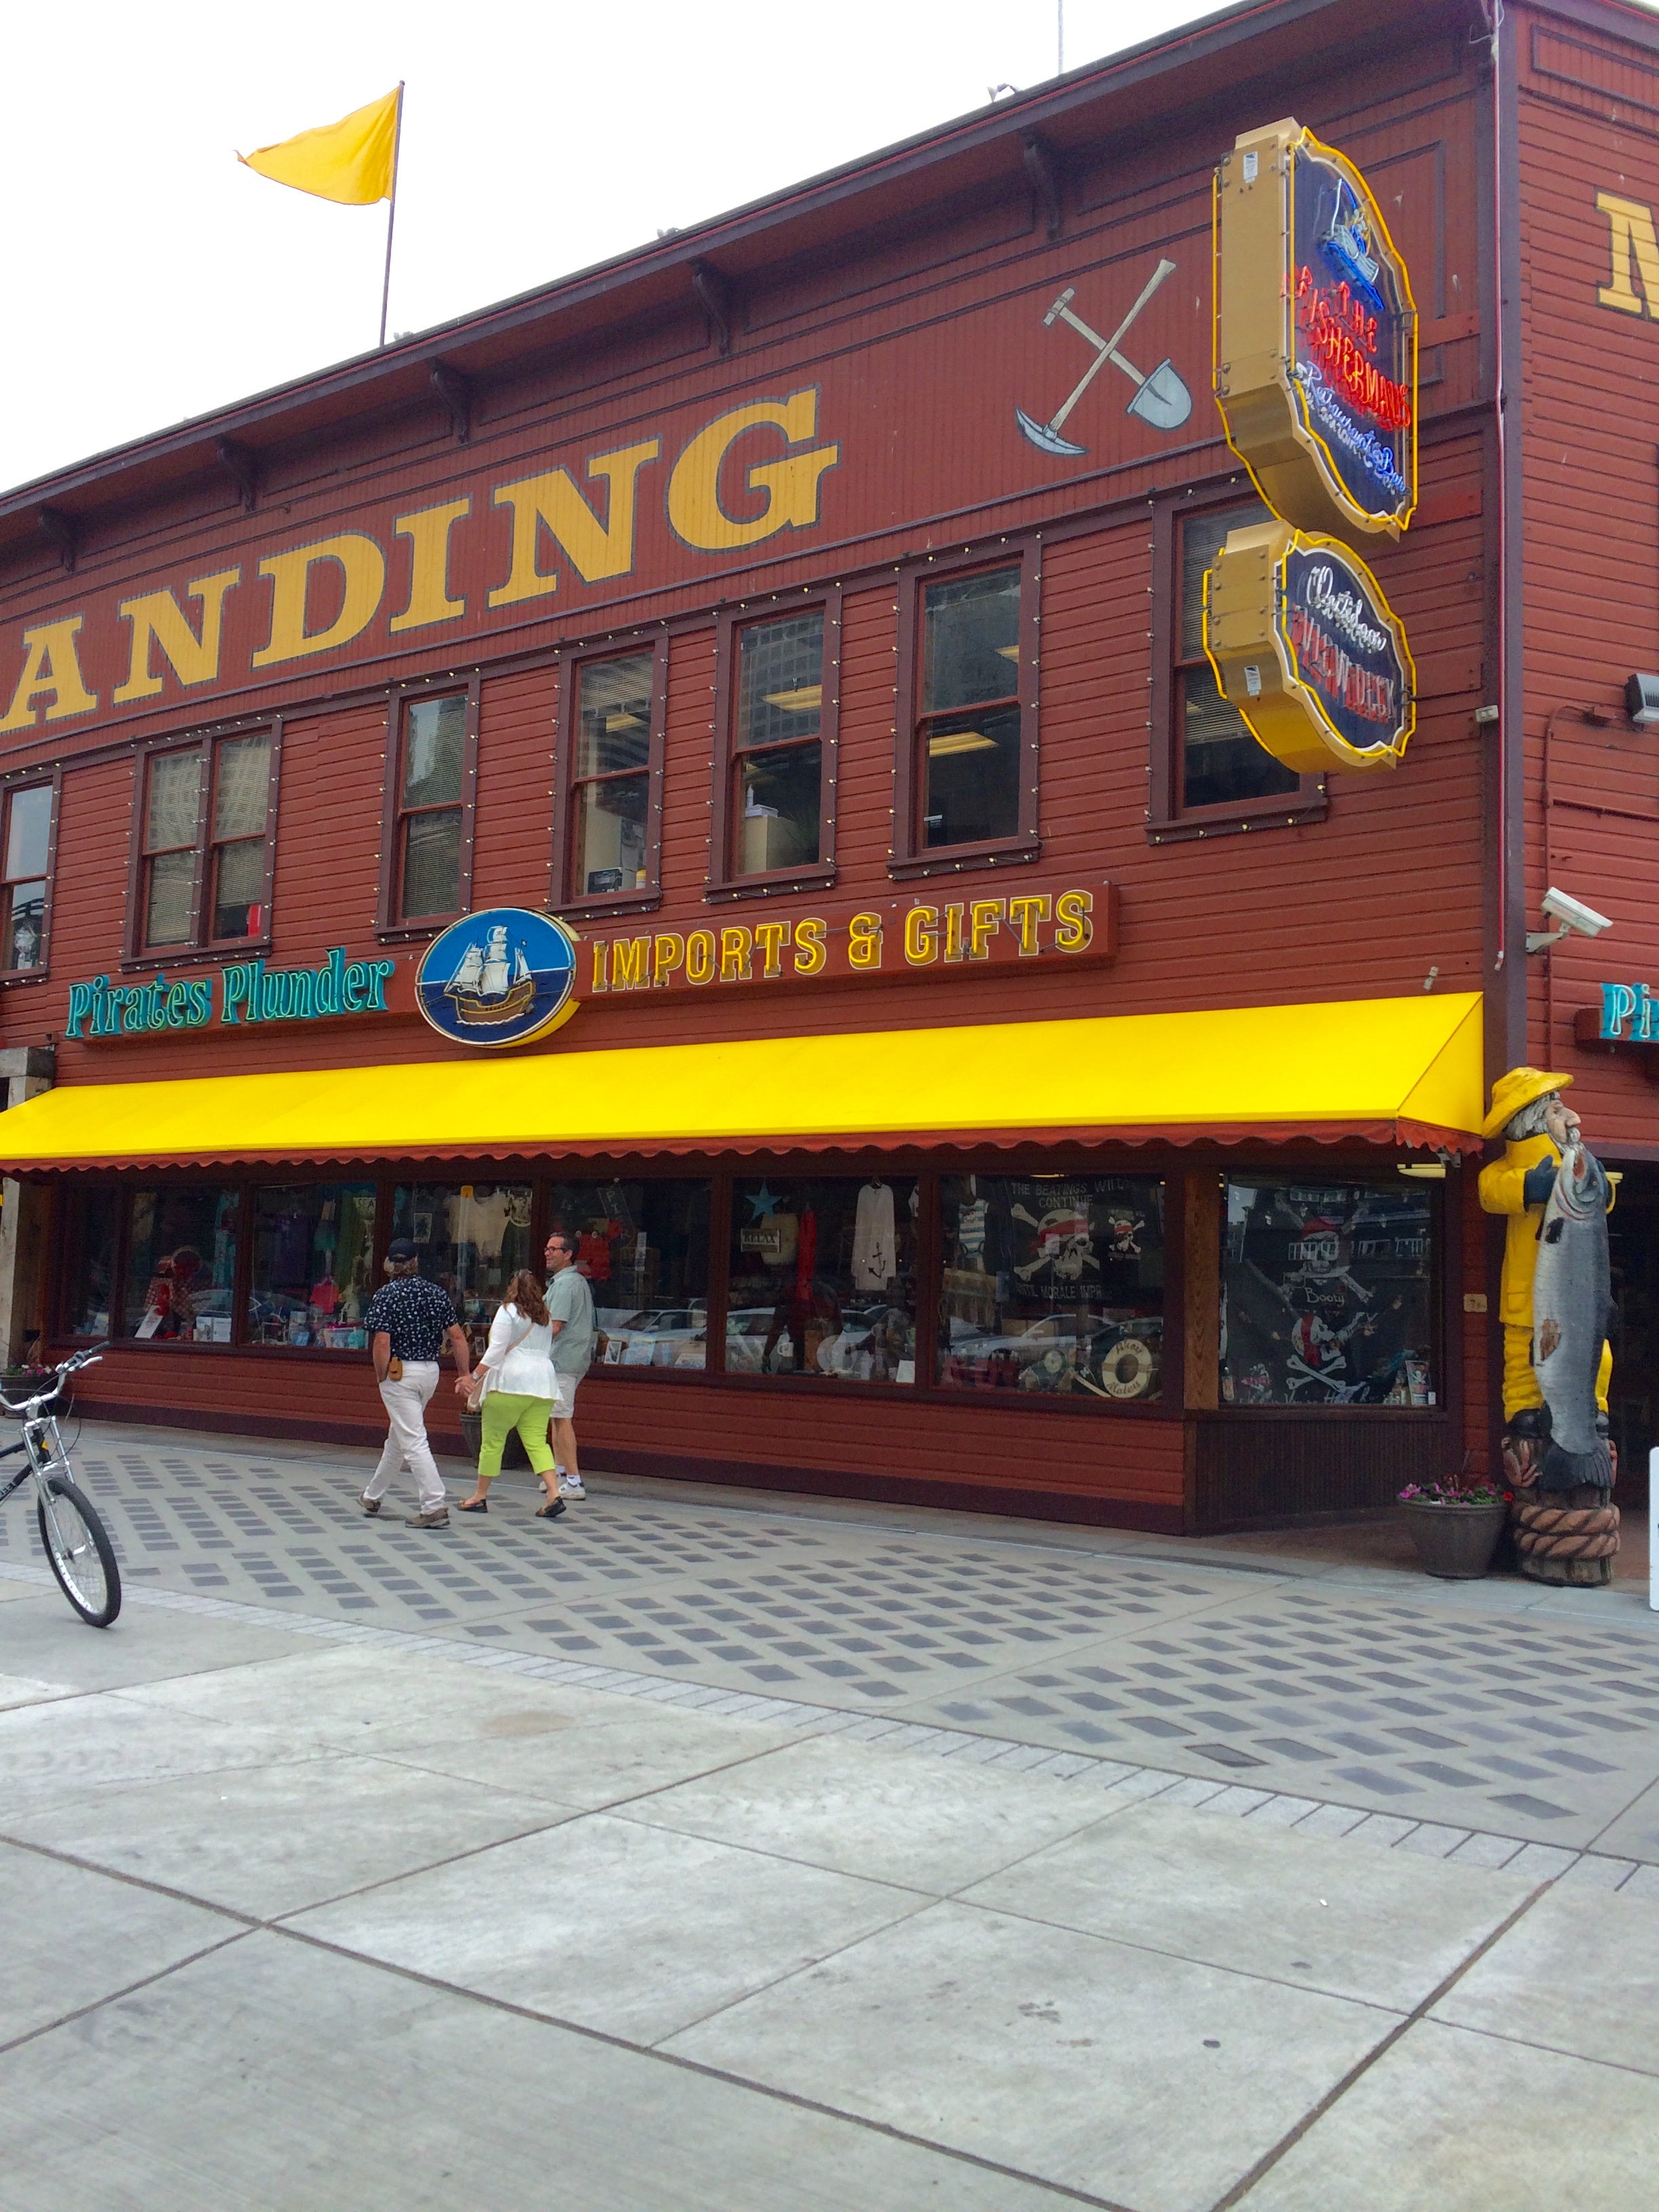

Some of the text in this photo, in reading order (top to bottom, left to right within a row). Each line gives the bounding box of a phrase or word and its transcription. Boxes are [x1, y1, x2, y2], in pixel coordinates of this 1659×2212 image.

[0, 385, 839, 733] ANDING
[592, 888, 1094, 994] IMPORTS & GIFTS
[65, 946, 396, 1038] Pirates Plunder
[1599, 982, 1659, 1042] Pi
[1010, 1182, 1031, 1196] THE
[1035, 1182, 1088, 1197] BEATINGS
[1038, 1194, 1094, 1208] CONTINUE
[742, 1229, 777, 1245] RELAX
[1305, 1287, 1346, 1307] Booty
